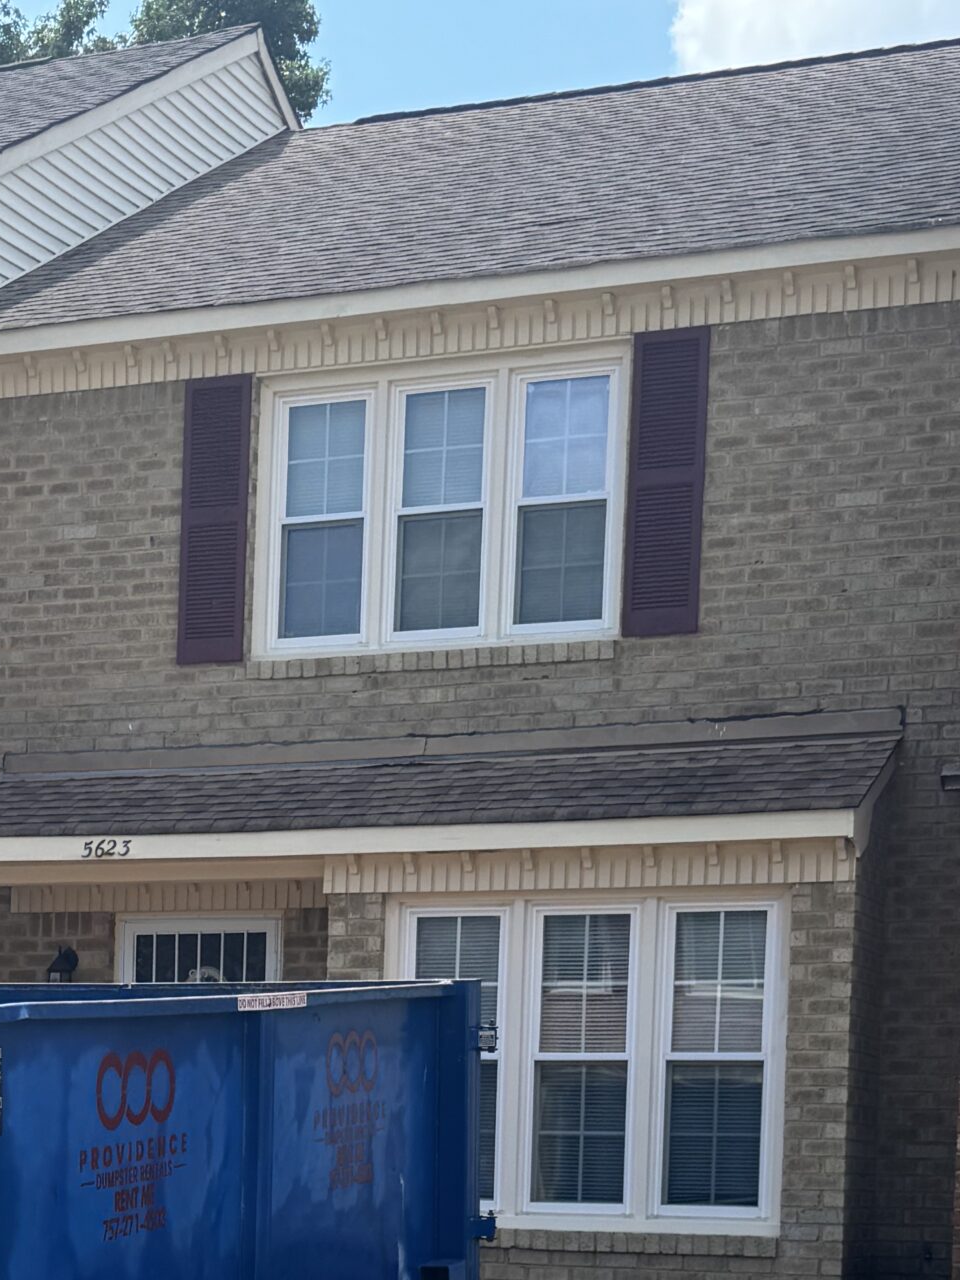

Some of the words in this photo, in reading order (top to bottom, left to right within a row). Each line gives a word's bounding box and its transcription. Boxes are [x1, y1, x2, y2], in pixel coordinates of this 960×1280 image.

[81, 839, 132, 858] 5623
[79, 1132, 188, 1173] PROVIDENCE
[95, 1167, 138, 1190] DUMPSTER
[140, 1160, 173, 1182] RENTALS
[114, 1185, 139, 1213] RENT
